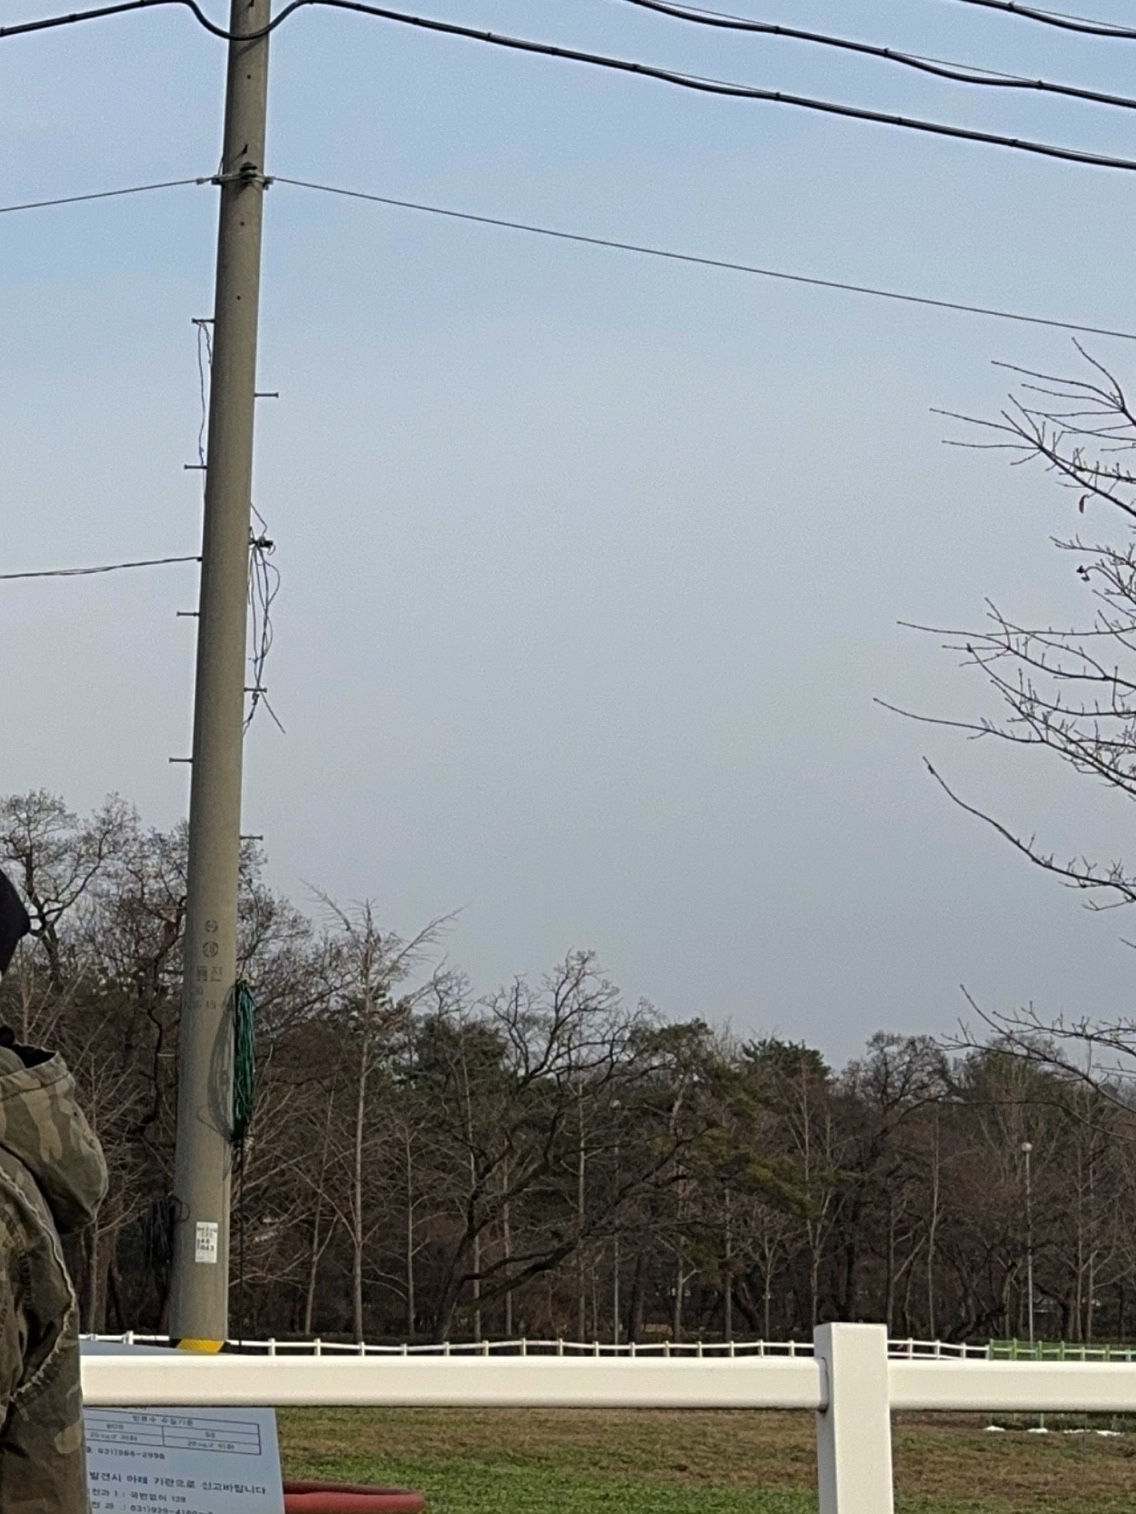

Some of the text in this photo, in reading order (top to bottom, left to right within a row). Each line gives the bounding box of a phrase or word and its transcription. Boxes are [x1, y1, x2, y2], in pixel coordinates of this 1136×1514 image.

[89, 1471, 122, 1483] 발견시
[126, 1474, 148, 1485] 아래
[153, 1477, 196, 1489] 기관으로
